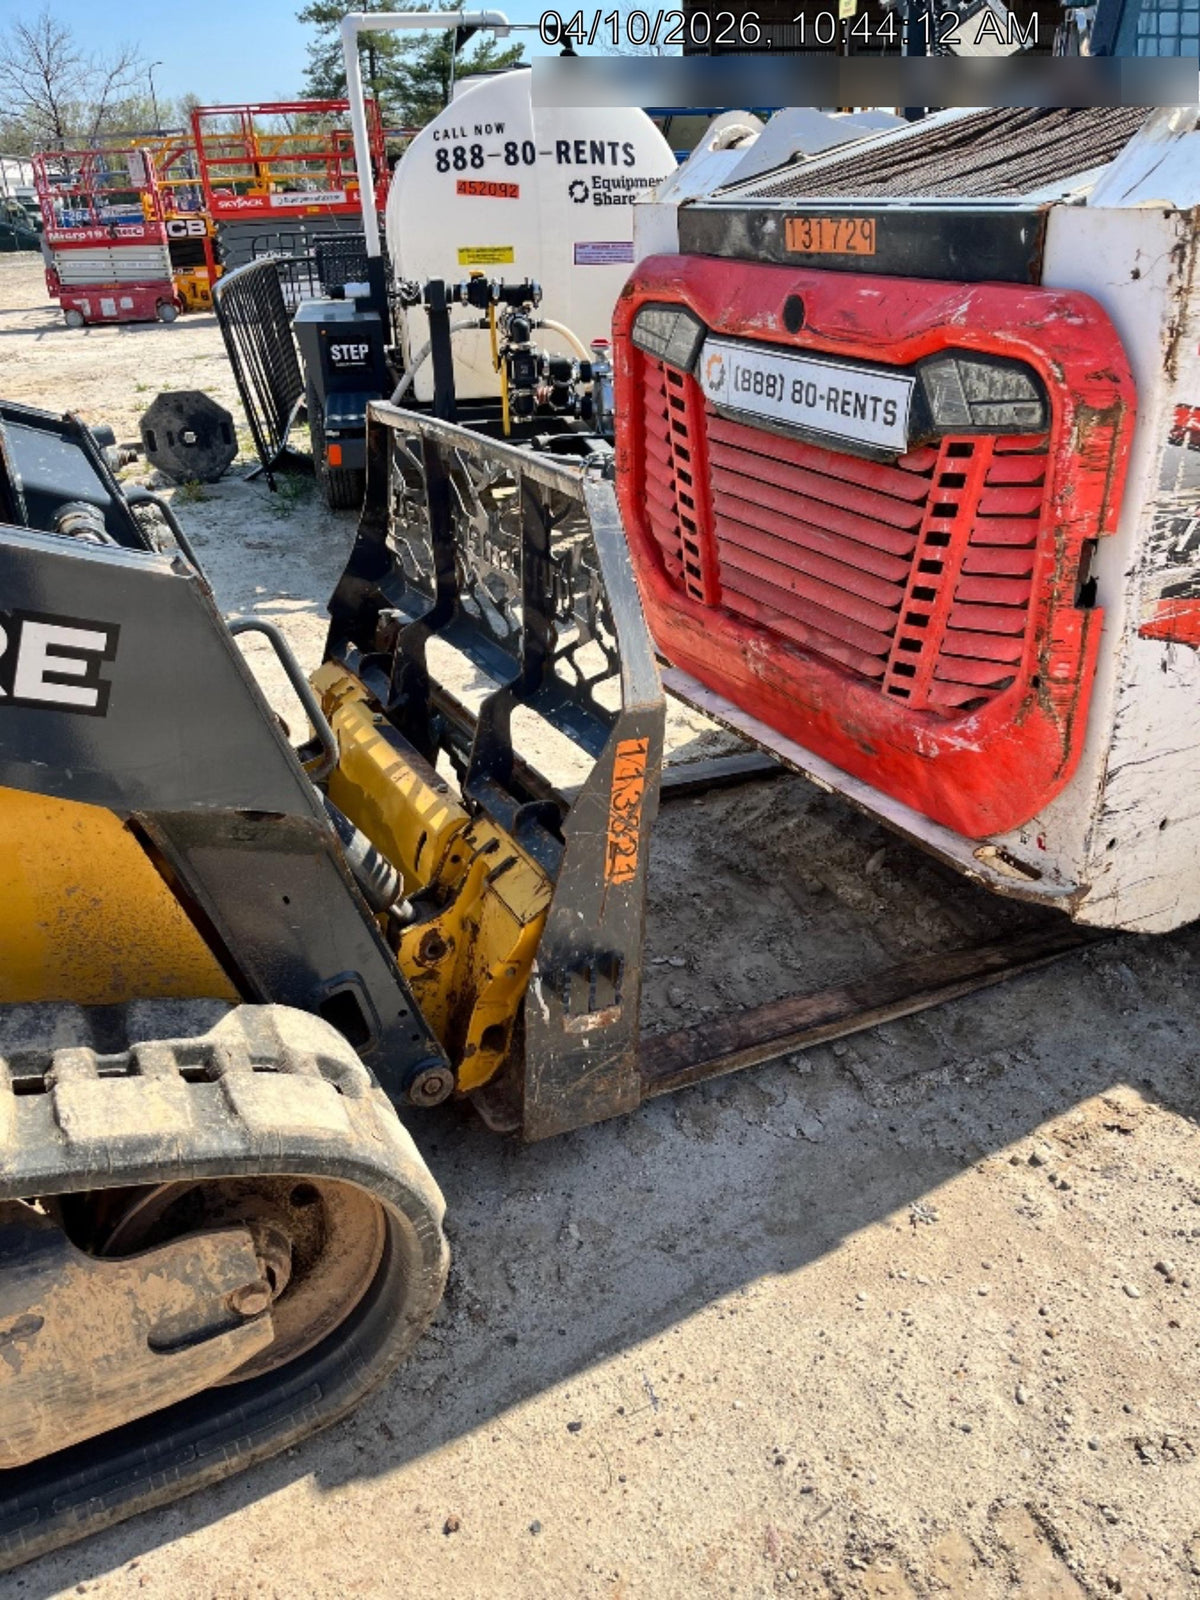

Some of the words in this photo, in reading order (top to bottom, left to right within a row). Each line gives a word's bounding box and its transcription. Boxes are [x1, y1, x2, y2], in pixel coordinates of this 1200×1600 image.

[433, 127, 467, 140] CALL
[474, 122, 505, 136] NOW
[435, 139, 636, 173] 888-80-RENTS
[458, 181, 519, 198] 452092
[593, 192, 636, 206] Share
[166, 219, 207, 237] CB
[788, 219, 873, 252] 131729
[330, 344, 369, 360] STEP
[733, 365, 785, 402] (888)
[790, 379, 898, 427] 80-RENTS
[0, 620, 107, 707] E
